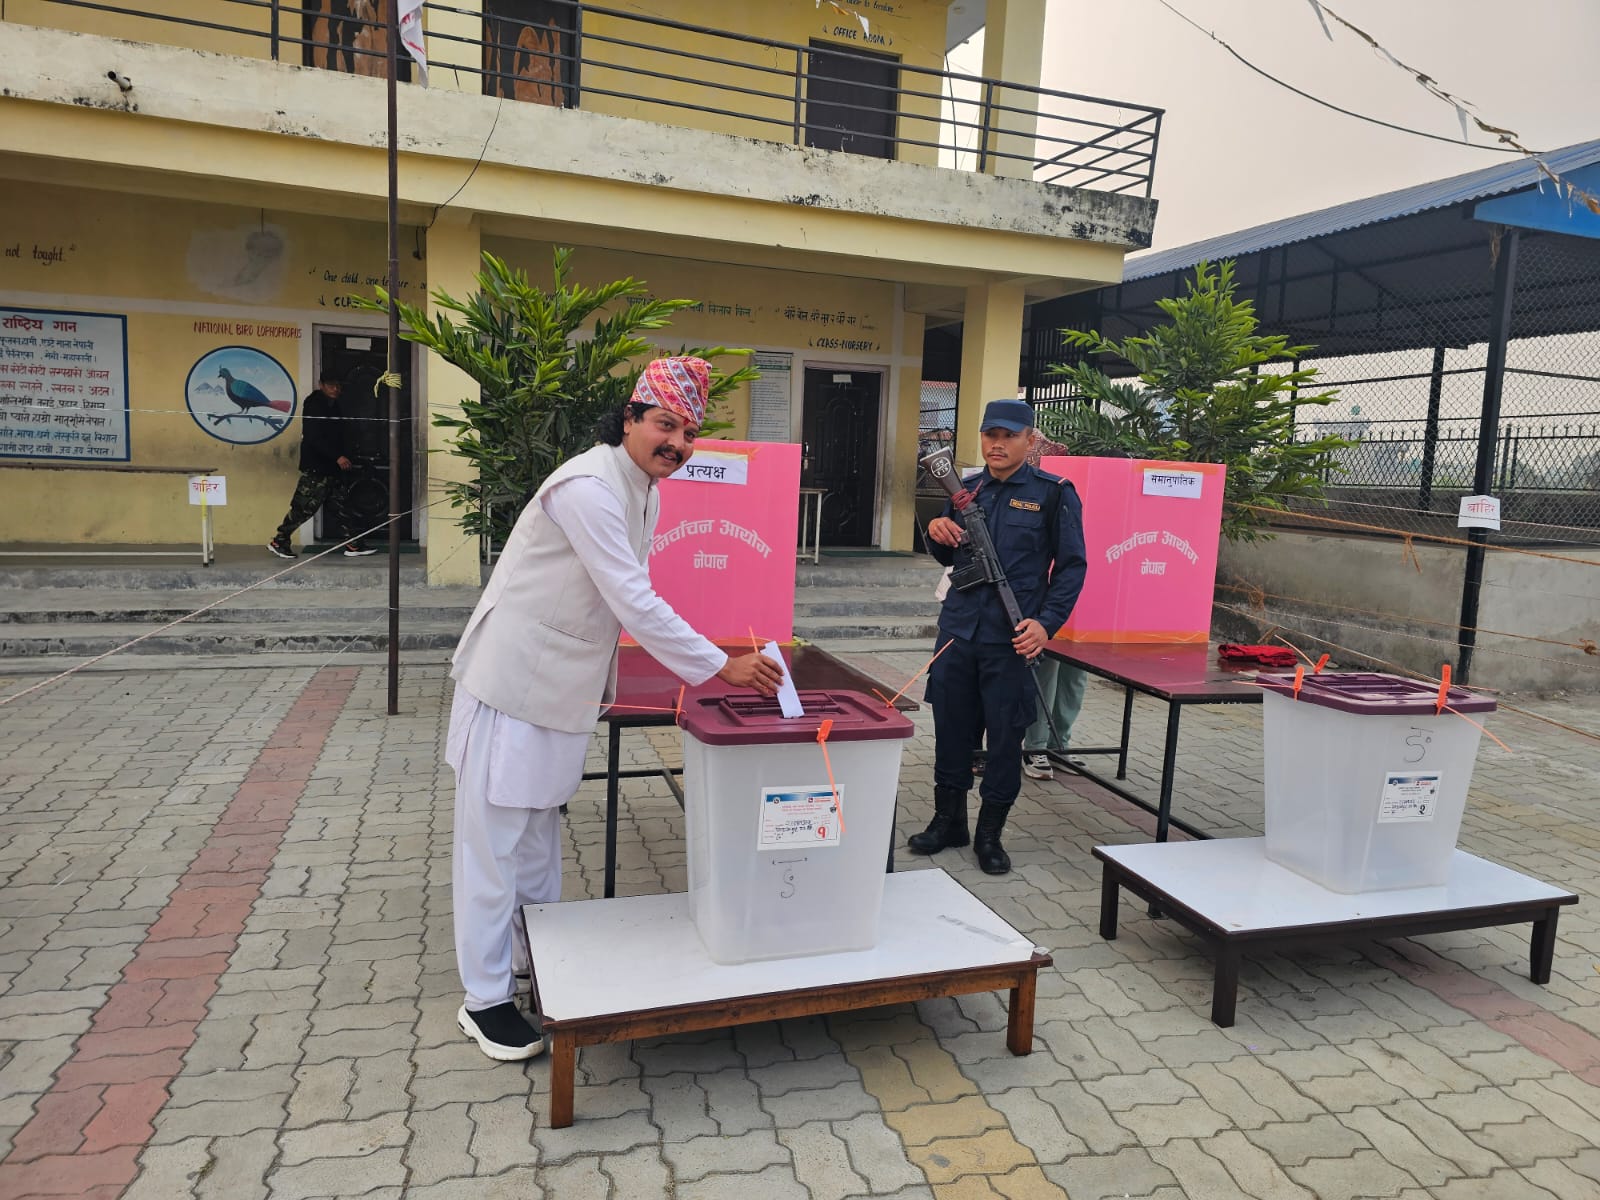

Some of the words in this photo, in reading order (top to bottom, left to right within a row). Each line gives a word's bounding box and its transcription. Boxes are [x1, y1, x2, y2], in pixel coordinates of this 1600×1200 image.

[833, 26, 857, 39] OFFICE
[5, 242, 21, 258] not
[53, 320, 78, 333] गान
[193, 320, 233, 336] NATIONAL
[686, 464, 726, 480] प्रत्यक्ष
[192, 480, 220, 493] बाहिर
[1151, 473, 1196, 488] समानुपातिक
[719, 519, 772, 559] आयोग
[1105, 530, 1159, 564] निर्वाचन
[1162, 530, 1199, 565] आयोग
[693, 549, 729, 570] नेपाल
[1141, 557, 1167, 575] नेपाल
